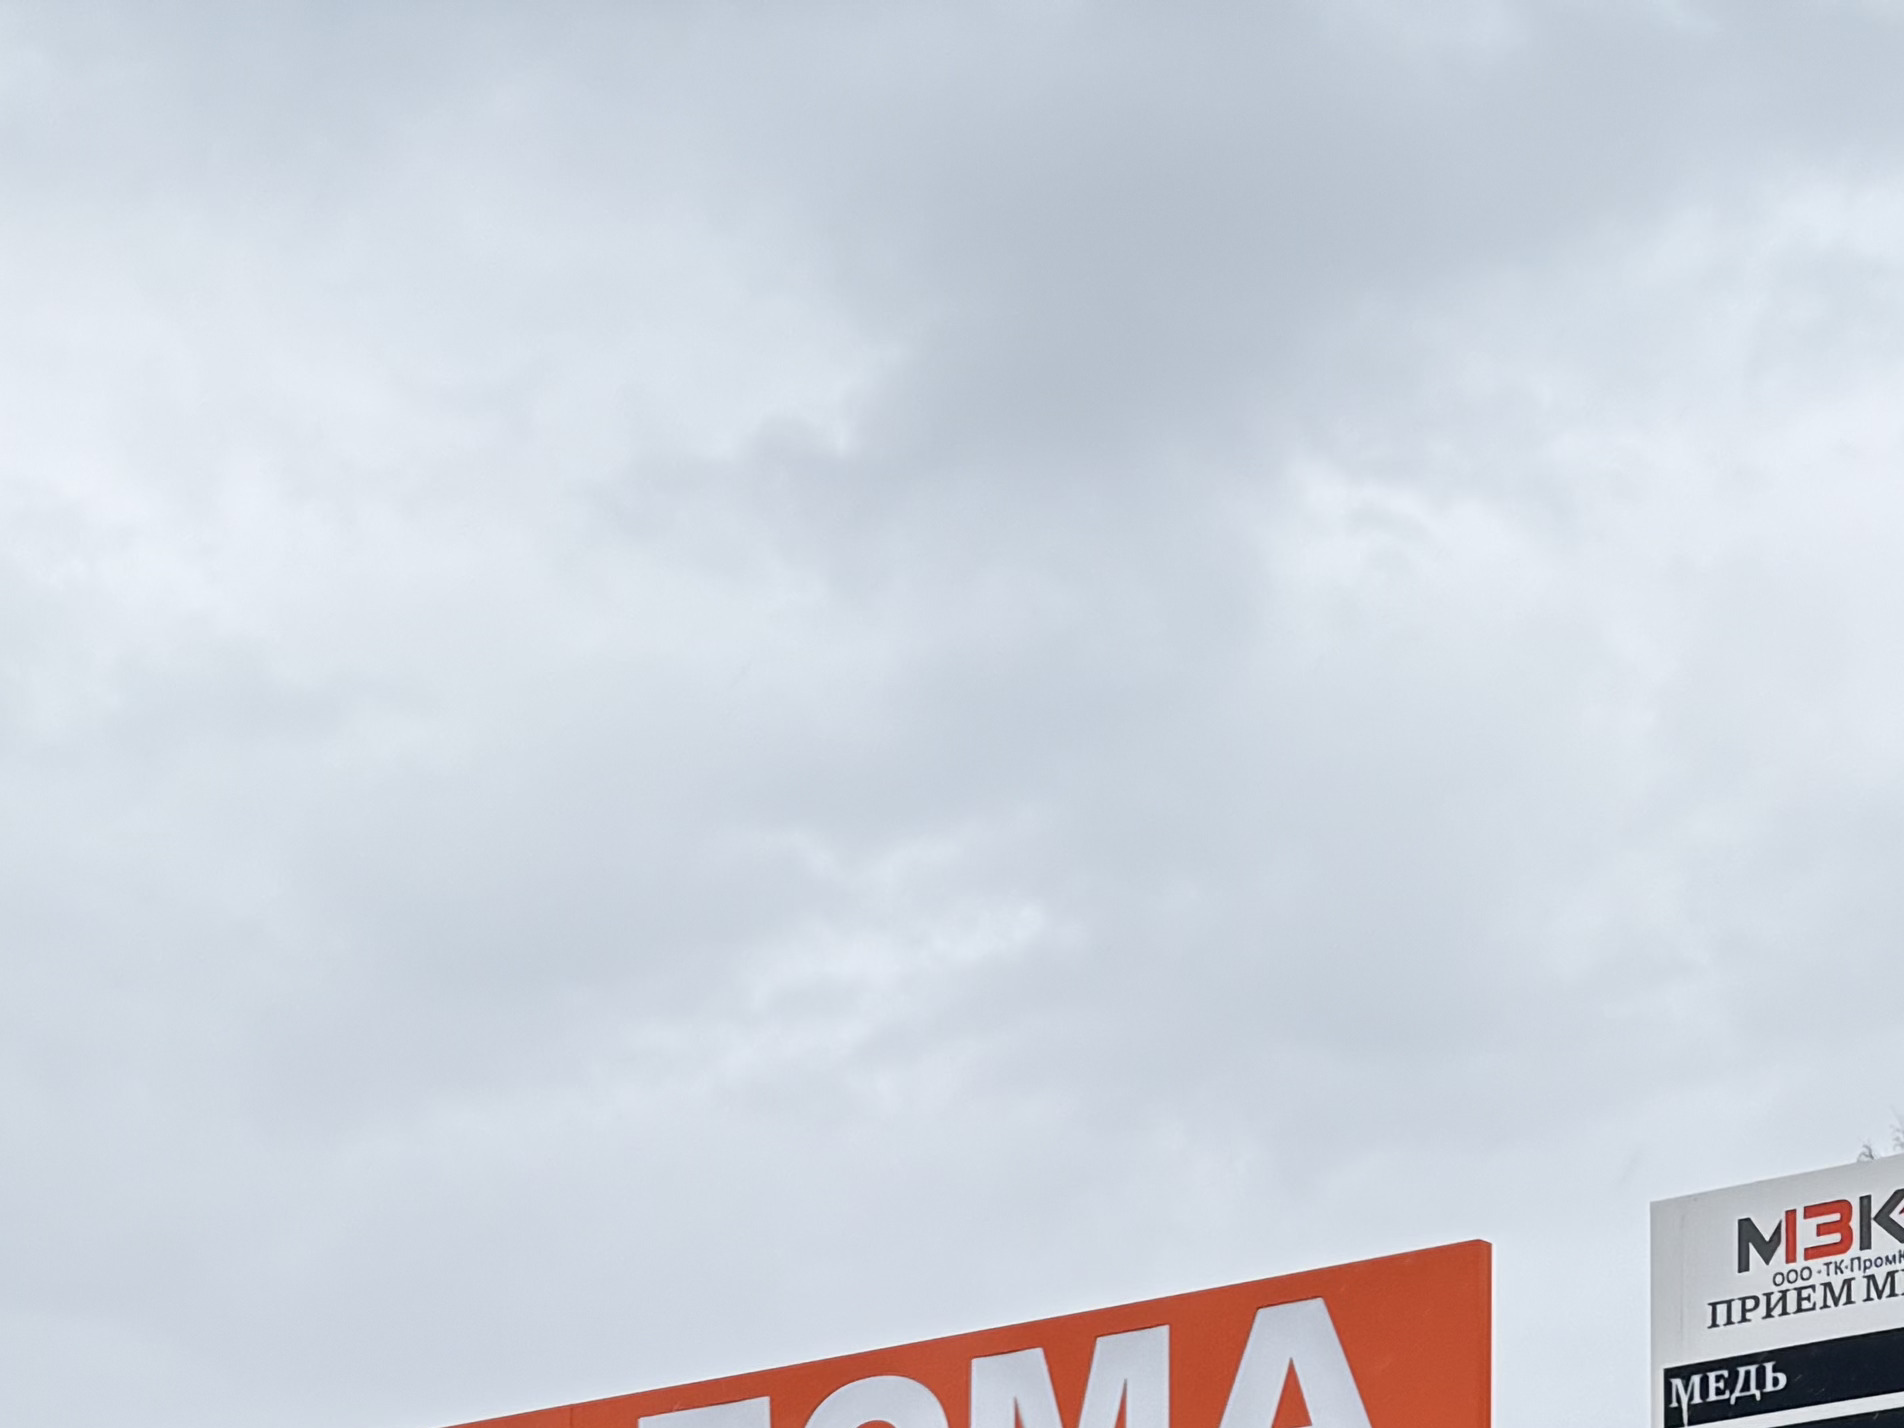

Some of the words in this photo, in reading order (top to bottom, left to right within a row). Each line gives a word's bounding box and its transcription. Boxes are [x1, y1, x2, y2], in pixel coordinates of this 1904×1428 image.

[1772, 1266, 1813, 1287] ООО
[1707, 1277, 1857, 1329] ПРИЕМ
[1669, 1361, 1787, 1408] МЕДЬ
